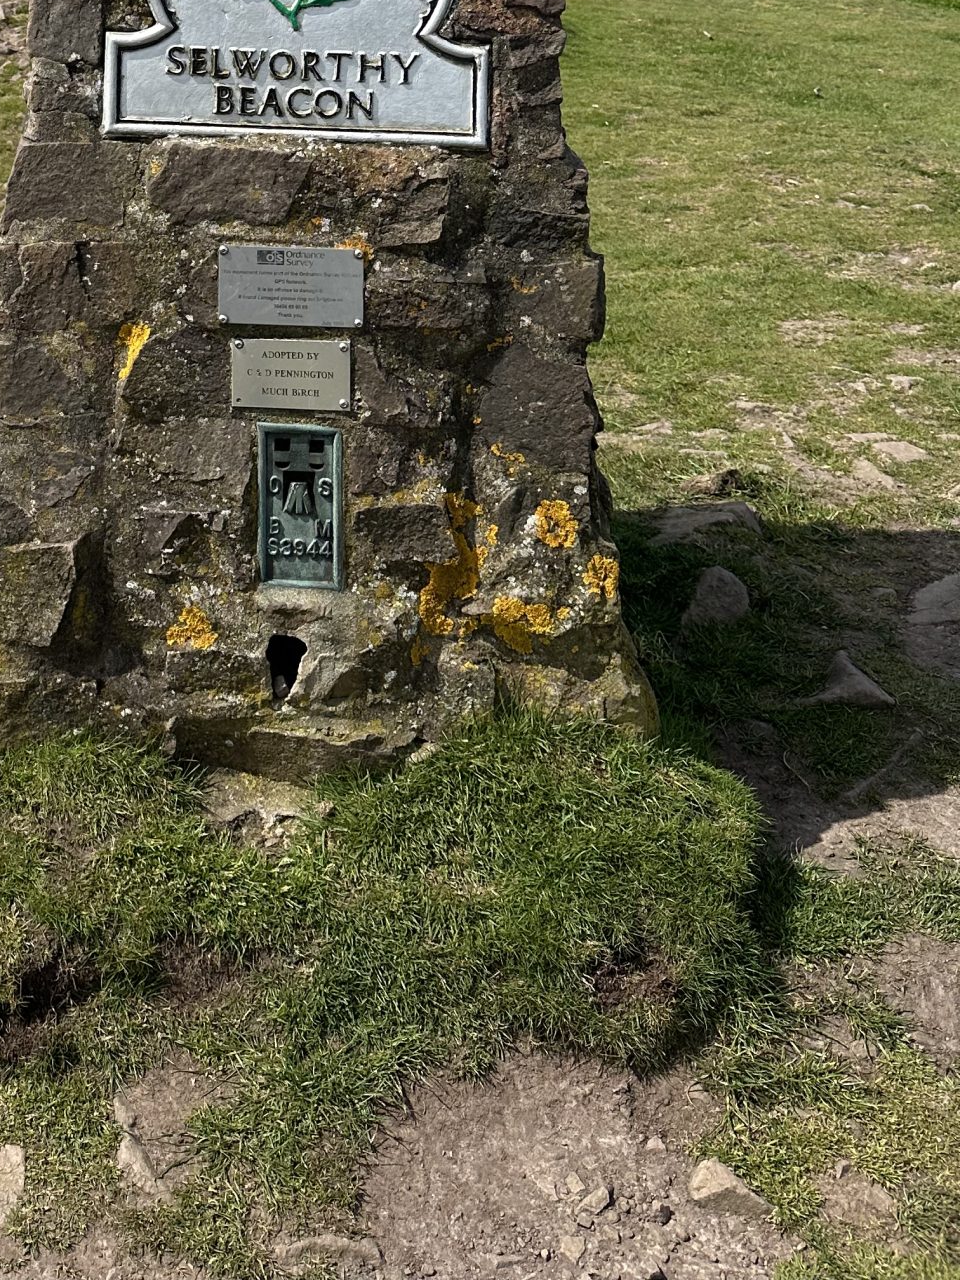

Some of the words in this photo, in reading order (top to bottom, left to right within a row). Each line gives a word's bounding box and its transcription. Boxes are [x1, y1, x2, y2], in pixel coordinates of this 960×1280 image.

[165, 45, 421, 85] SELWORTHY
[213, 85, 375, 120] BEACON
[285, 250, 326, 260] Ordnance
[285, 258, 314, 268] Survey
[261, 351, 303, 360] ADOPTED
[306, 352, 320, 360] BY
[247, 368, 253, 376] C
[274, 369, 334, 379] PENNINGTON
[261, 387, 288, 396] MUCH
[291, 388, 320, 397] BIRCH
[269, 475, 282, 493] O
[318, 477, 332, 496] S
[269, 516, 280, 535] B
[314, 518, 332, 538] M
